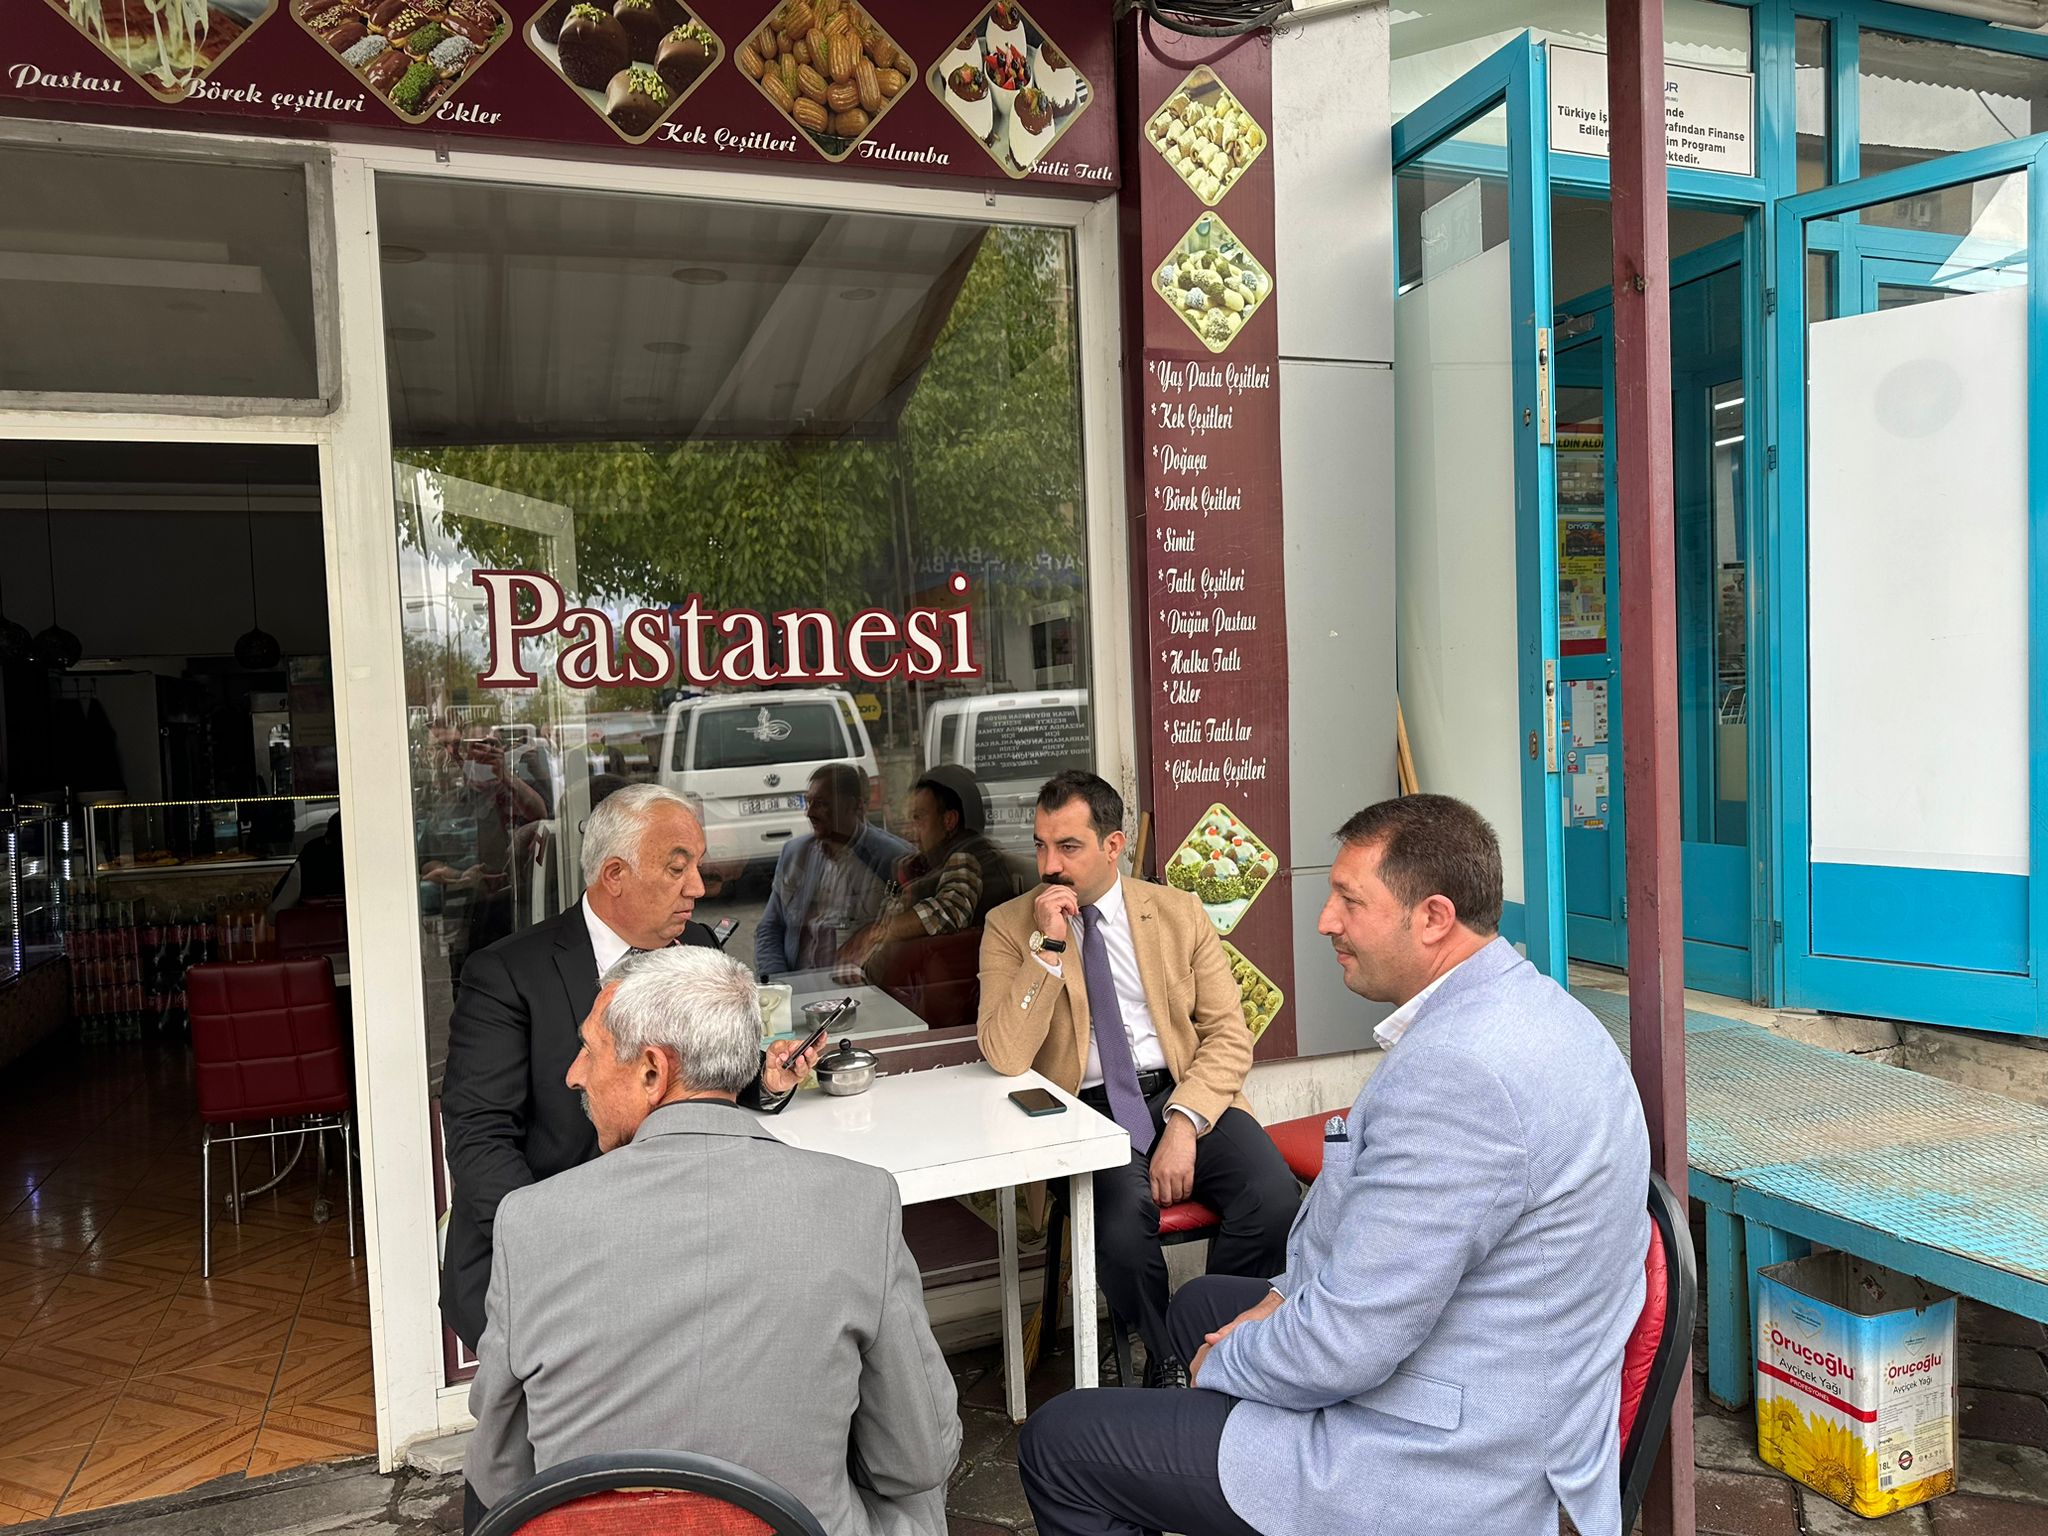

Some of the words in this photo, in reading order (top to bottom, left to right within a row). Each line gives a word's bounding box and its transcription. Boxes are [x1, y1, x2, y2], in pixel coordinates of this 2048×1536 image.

[8, 63, 125, 94] Pastası
[184, 76, 263, 105] Börek
[271, 88, 366, 114] çeşitleri
[435, 100, 502, 125] Ekler
[1557, 105, 1597, 121] Türkiye
[1599, 108, 1608, 123] İş
[1666, 107, 1685, 118] nde
[657, 121, 707, 145] Kek
[713, 126, 798, 154] Çeşitleri
[1665, 121, 1706, 136] rafından
[1708, 127, 1745, 142] Finanse
[1666, 136, 1679, 147] im
[1682, 138, 1726, 154] Programı
[857, 139, 951, 166] Tulumba
[1027, 159, 1069, 178] Sütlü
[1074, 162, 1114, 181] Tatlı
[1157, 360, 1184, 394] Yaş
[1185, 360, 1223, 392] Pasta
[1225, 361, 1271, 395] Çeşitleri
[1159, 402, 1186, 429] Kek
[1188, 402, 1234, 436] Çeşitleri
[1160, 444, 1208, 476] Poğaça
[1162, 485, 1200, 511] Börek
[1163, 527, 1196, 552] Simit
[1166, 567, 1197, 593] Tatlı
[1200, 566, 1245, 599] Çeşitleri
[472, 569, 982, 688] Pastanesi
[1167, 608, 1209, 639] Düğün
[1212, 607, 1258, 637] Pastası
[1169, 649, 1209, 674] Halka
[1211, 647, 1242, 673] Tatlı
[1170, 680, 1202, 705] Ekler
[1170, 719, 1202, 744] Sütlü
[1172, 759, 1220, 790] Çikolata
[1223, 756, 1266, 788] Çeşitleri
[1771, 1329, 1855, 1380] Oruçoğlu
[1888, 1353, 1942, 1378] Oruçoğlu
[1779, 1357, 1817, 1383] Ayçiçek
[1818, 1376, 1842, 1395] Yağı
[1789, 1377, 1831, 1402] PROFESYONEL
[1893, 1381, 1918, 1394] Ayçiçek
[1919, 1376, 1933, 1388] Yağı
